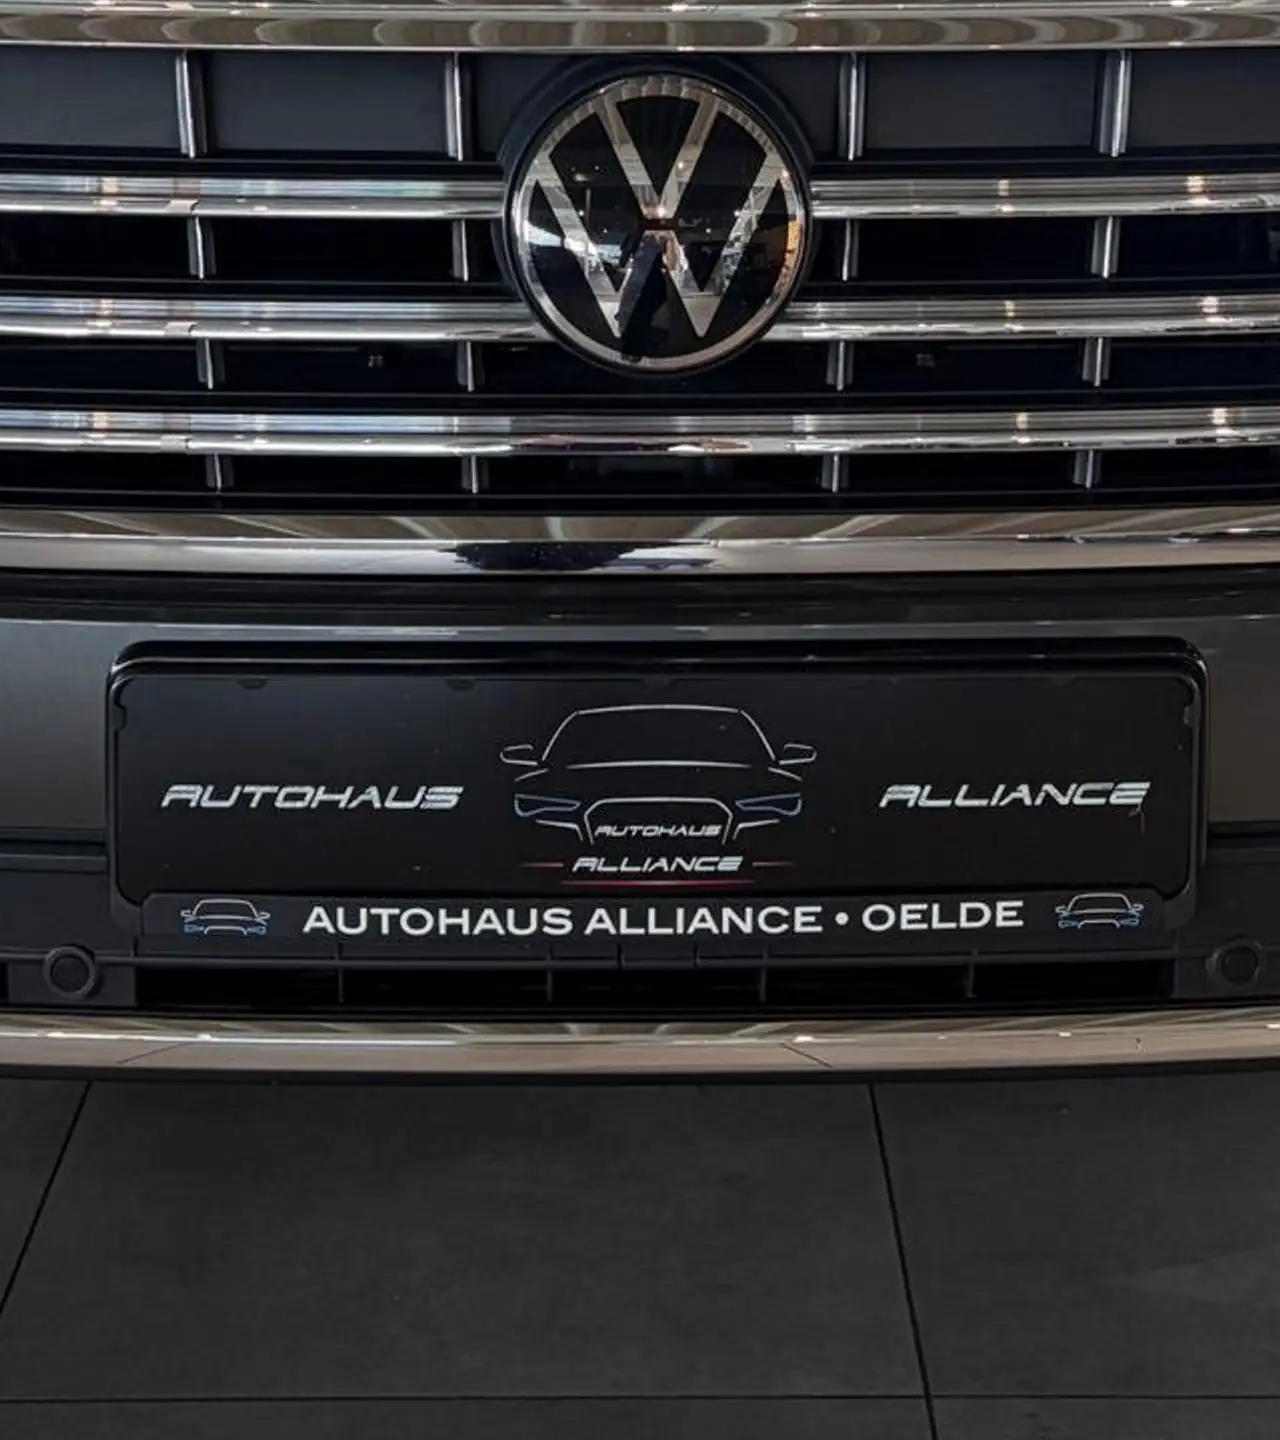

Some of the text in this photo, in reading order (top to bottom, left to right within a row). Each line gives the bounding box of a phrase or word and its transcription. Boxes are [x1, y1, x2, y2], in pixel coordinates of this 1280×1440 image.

[520, 88, 795, 340] VW
[160, 784, 465, 809] AUTOHAUS
[878, 781, 1152, 808] ALLIANCE
[593, 823, 724, 838] AUTOHAUS
[571, 855, 744, 873] ALLIANCE
[302, 899, 1025, 936] AUTOHAUS ALLIANCE OELDE
